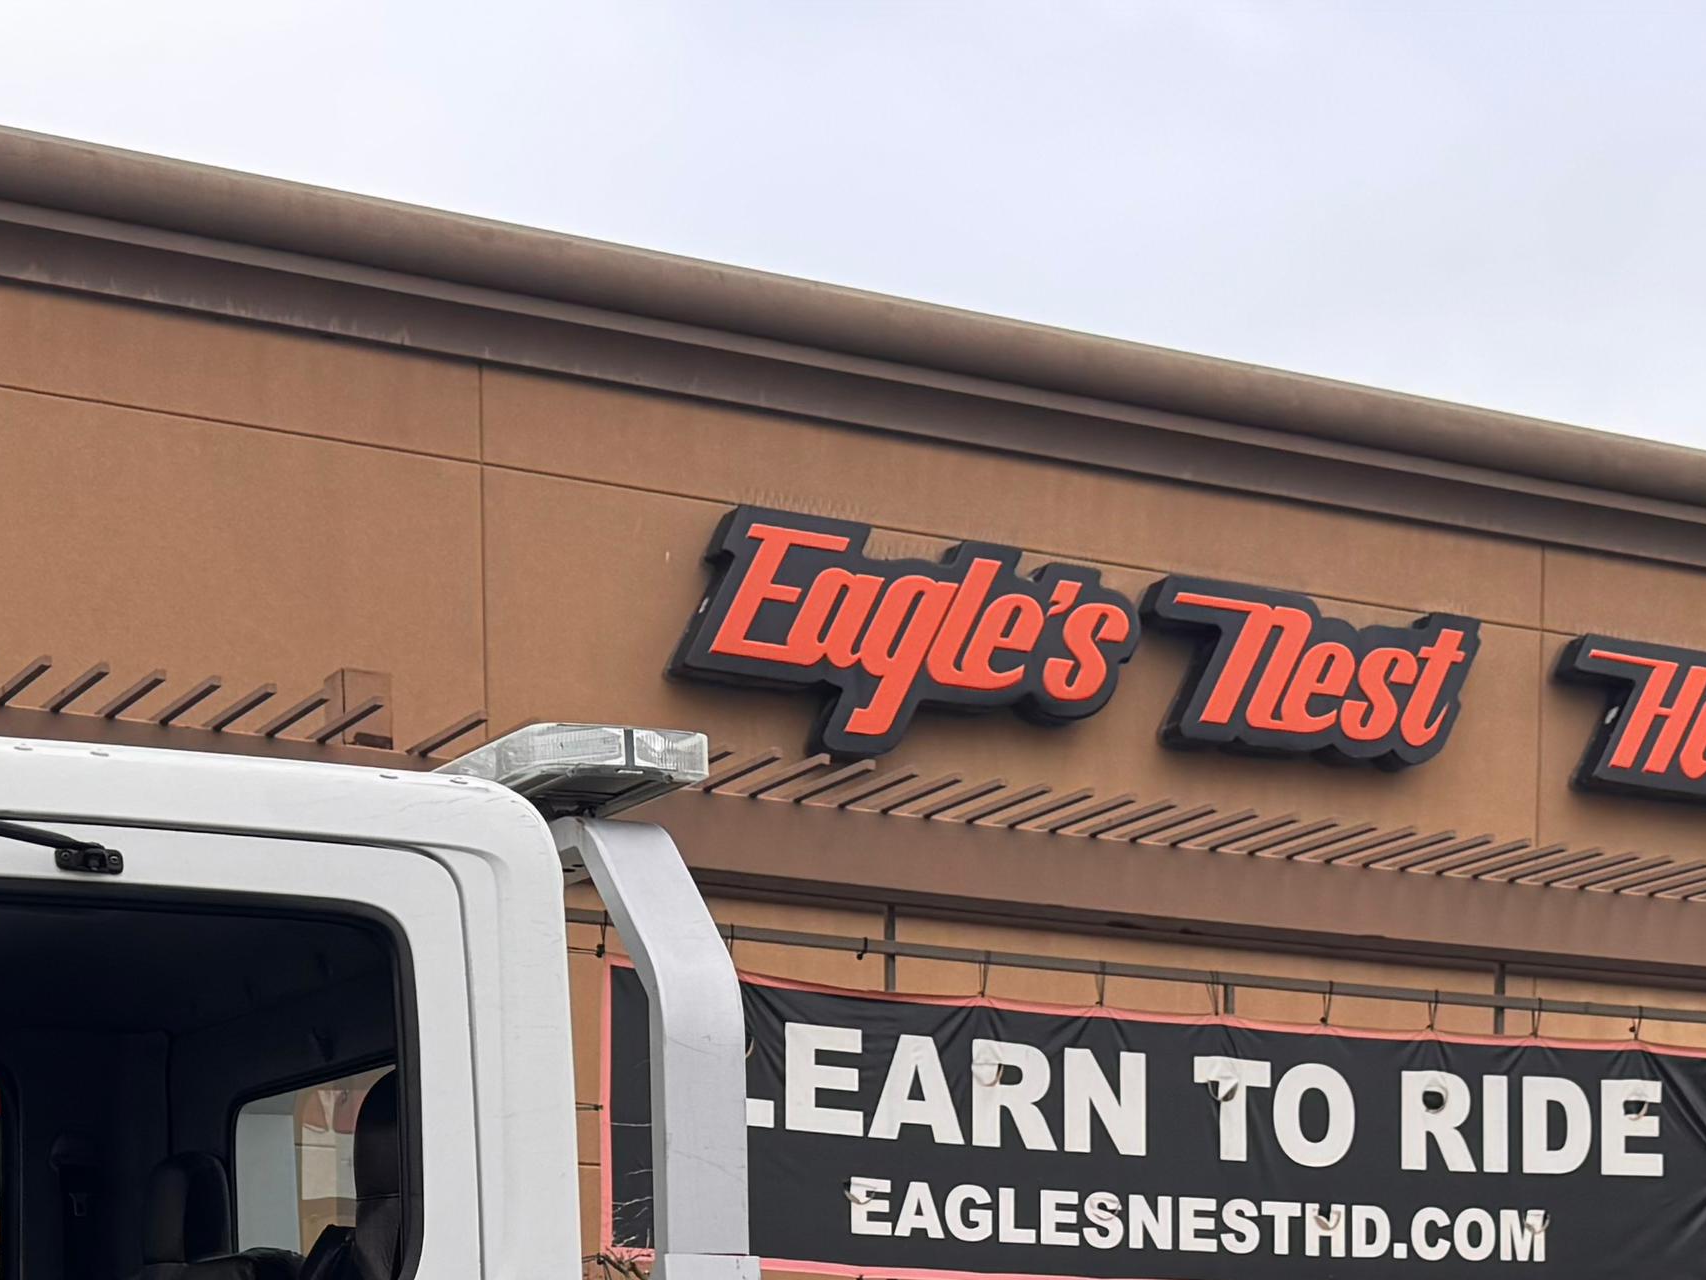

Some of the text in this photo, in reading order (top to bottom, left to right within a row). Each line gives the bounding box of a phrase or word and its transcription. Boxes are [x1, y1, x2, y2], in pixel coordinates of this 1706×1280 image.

[708, 523, 1130, 735] Eagle's
[1194, 1056, 1355, 1168] TO
[1401, 1070, 1663, 1177] RIDE
[850, 1176, 1546, 1262] EAGLESNESTHD.COM
